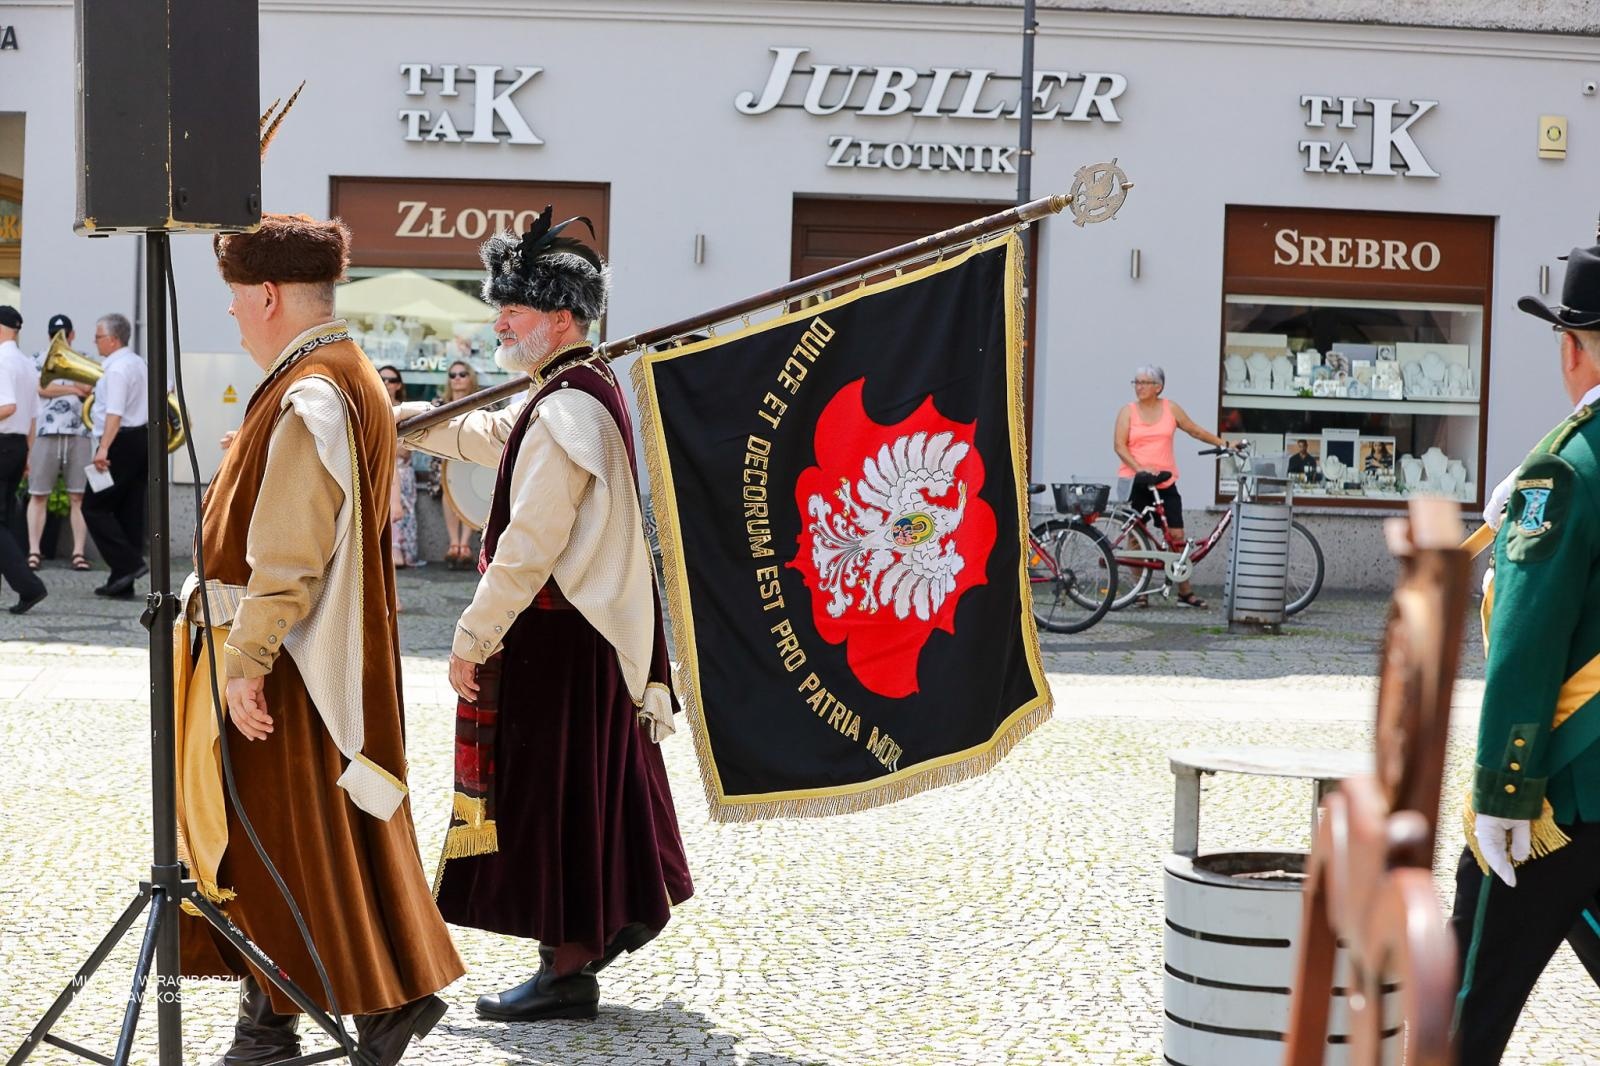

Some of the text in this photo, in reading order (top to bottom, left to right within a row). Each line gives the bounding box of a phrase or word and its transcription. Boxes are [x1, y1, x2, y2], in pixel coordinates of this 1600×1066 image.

[0, 25, 19, 50] A
[734, 46, 1129, 123] JUBILER
[825, 134, 1018, 174] ZŁOTNIK
[1274, 228, 1441, 272] SREBRO
[777, 316, 836, 395] DULCE
[758, 391, 788, 430] ET
[743, 434, 775, 558] DECORUM
[756, 565, 785, 611] EST
[770, 618, 807, 673] PRO
[798, 672, 861, 741] PATRIA
